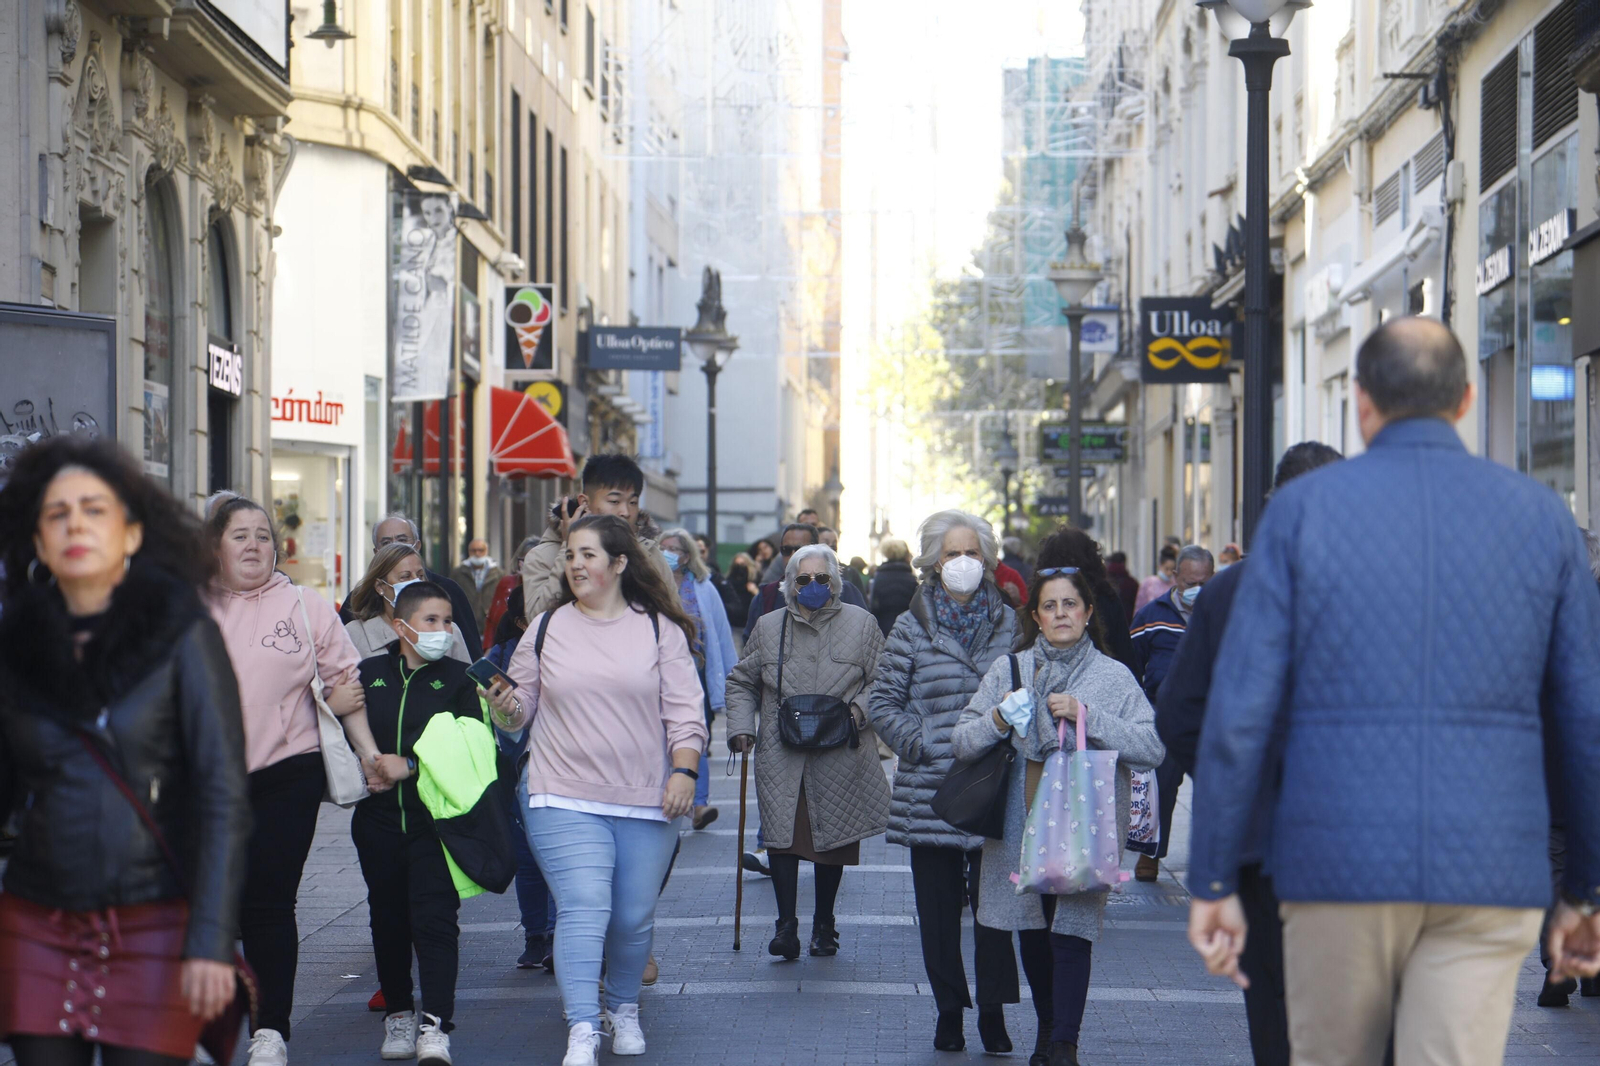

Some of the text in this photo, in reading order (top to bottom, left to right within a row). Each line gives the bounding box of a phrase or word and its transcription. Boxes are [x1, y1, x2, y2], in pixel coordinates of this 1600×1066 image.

[1528, 207, 1570, 267] CALZEDONIA
[401, 228, 425, 389] MATILDE CANO
[1147, 310, 1221, 337] Ulloa
